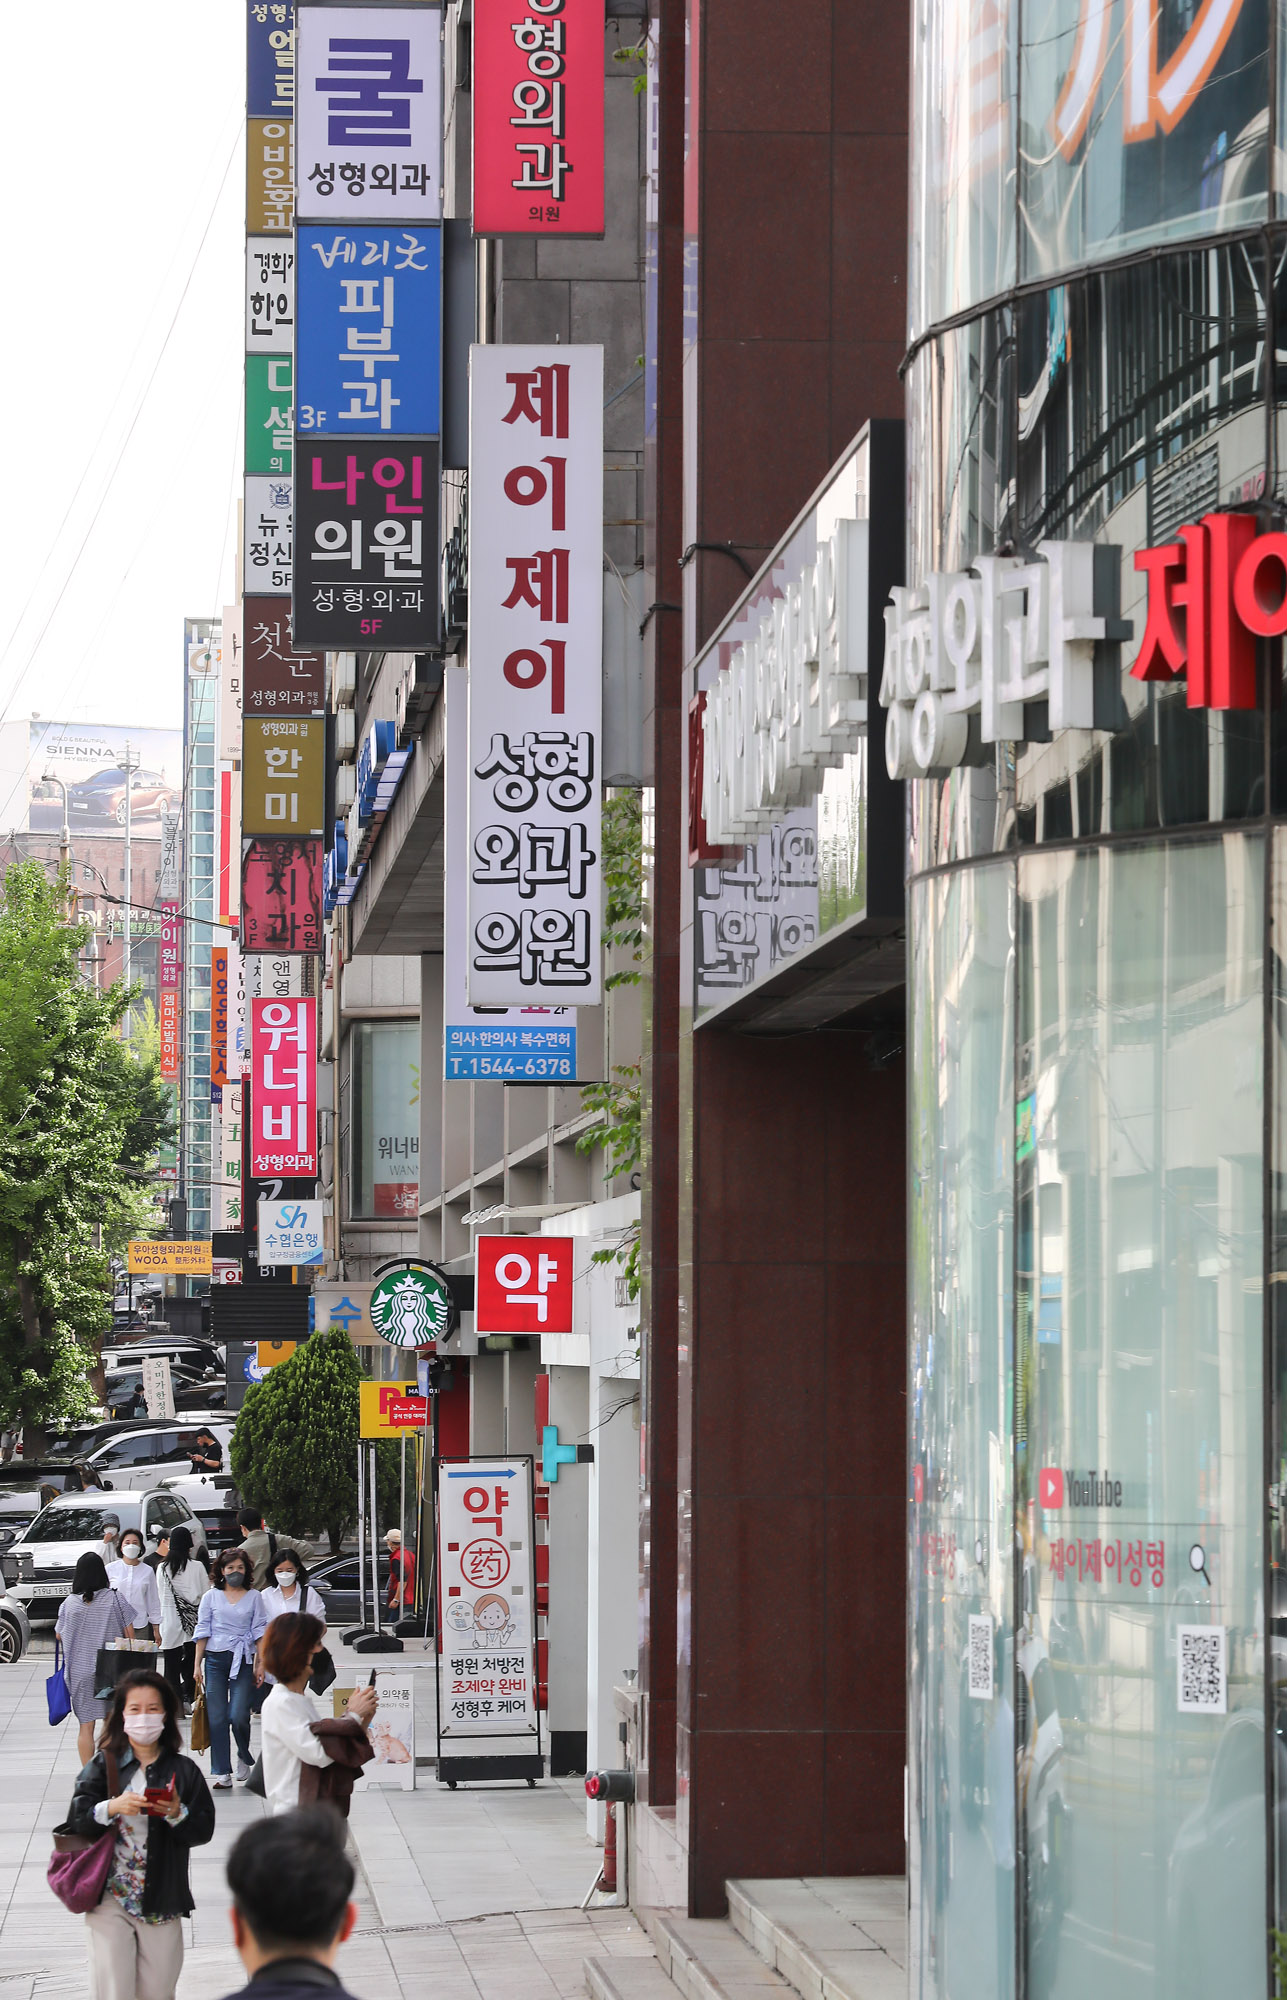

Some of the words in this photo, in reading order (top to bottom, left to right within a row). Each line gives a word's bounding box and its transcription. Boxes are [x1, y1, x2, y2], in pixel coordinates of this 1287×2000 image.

[315, 38, 423, 147] 쿨
[510, 0, 573, 201] 형외과
[307, 162, 431, 197] 성형외과
[529, 207, 560, 222] 의원
[338, 276, 401, 430] 피부과
[300, 405, 327, 429] 3F
[311, 455, 424, 514] 나인
[311, 519, 422, 578] 의원
[500, 363, 571, 714] 제이제이
[360, 619, 383, 634] 5F
[878, 540, 1120, 780] 성형외과
[249, 690, 305, 706] 성형외과
[261, 723, 298, 736] 성형외과
[46, 745, 115, 757] SIENNA
[264, 747, 302, 823] 한미
[474, 731, 594, 812] 성형
[473, 823, 596, 899] 외과
[265, 868, 301, 949] 치과
[473, 909, 592, 986] 의원
[450, 1031, 518, 1047] 의사·한의사
[520, 1032, 570, 1047] 복수면허
[259, 1002, 308, 1153] 워너비
[450, 1057, 571, 1075] T.1544-6378
[254, 1154, 315, 1171] 성형외과
[275, 1206, 308, 1229] Sh
[133, 1245, 201, 1255] 우아성형외과의원
[265, 1233, 318, 1248] 수협은행
[134, 1256, 168, 1265] WOOA
[494, 1253, 558, 1323] 약
[1066, 1469, 1122, 1508] YouTube
[463, 1486, 509, 1537] 약
[469, 1547, 503, 1581] 药
[1049, 1537, 1164, 1588] 제이제이성형
[450, 1658, 479, 1675] 병원
[482, 1657, 524, 1675] 처방전
[451, 1679, 495, 1695] 조제약
[498, 1679, 526, 1695] 완비
[451, 1700, 494, 1718] 성형후
[498, 1700, 526, 1714] 케어
